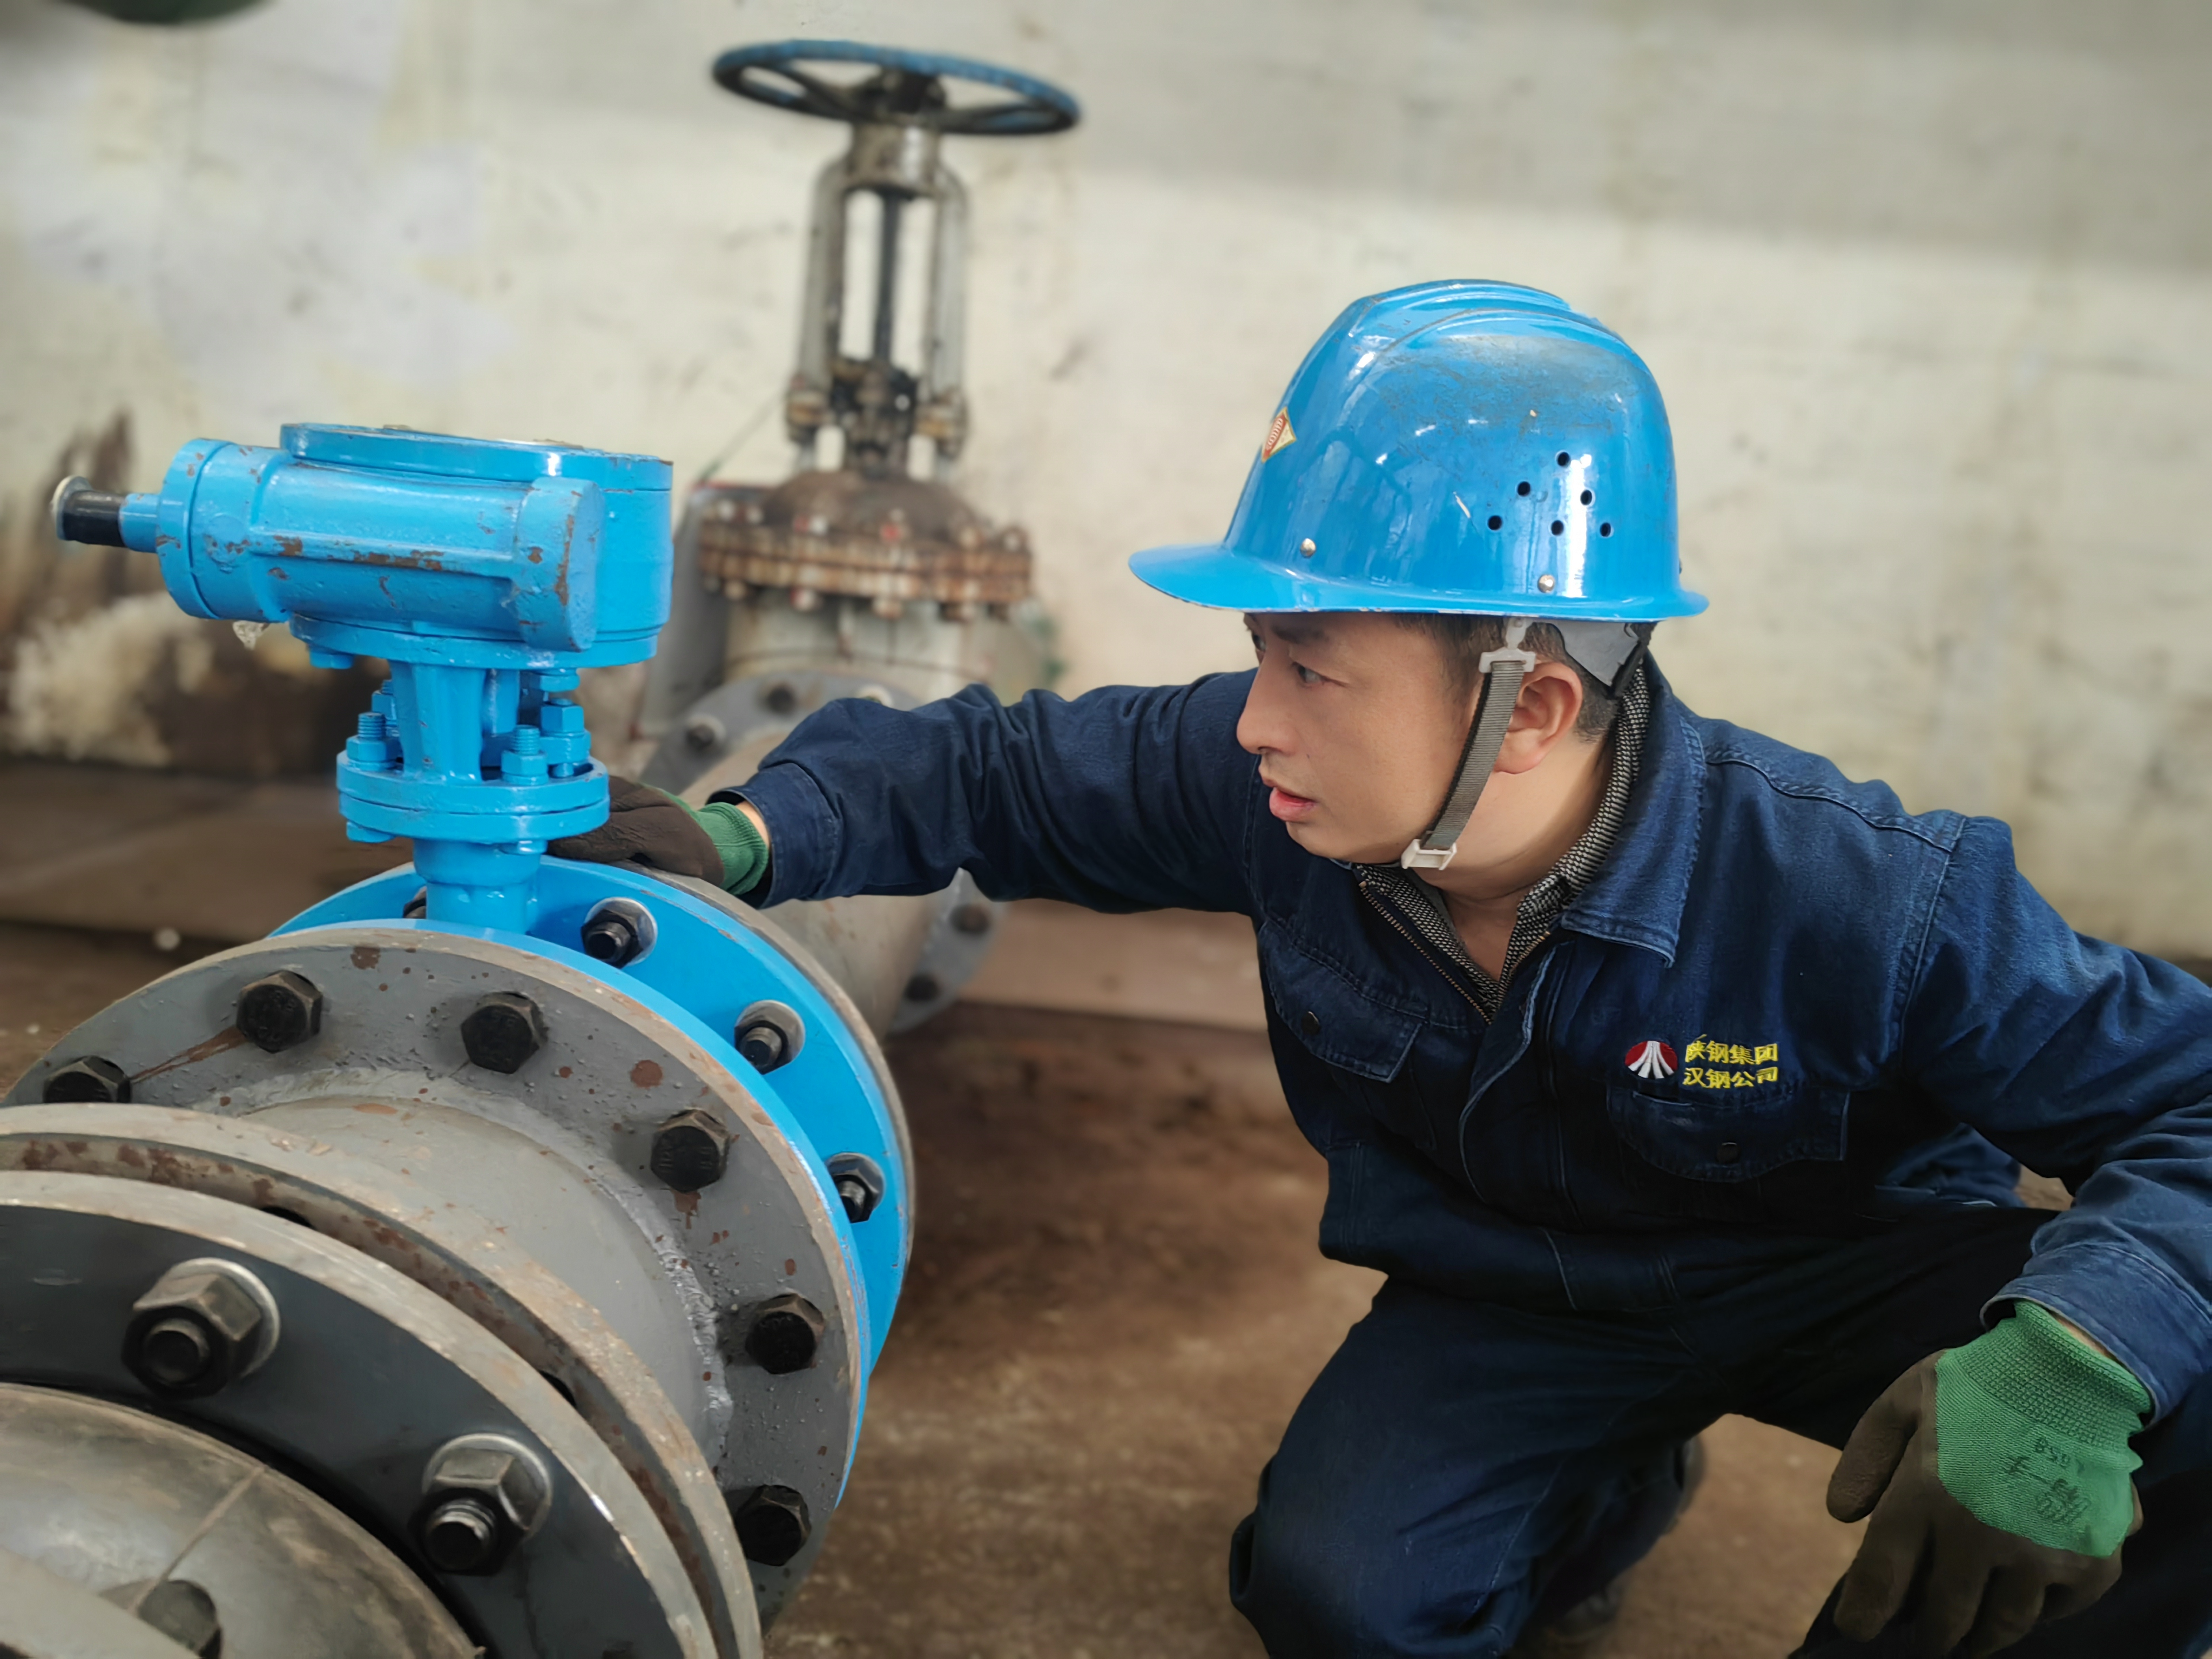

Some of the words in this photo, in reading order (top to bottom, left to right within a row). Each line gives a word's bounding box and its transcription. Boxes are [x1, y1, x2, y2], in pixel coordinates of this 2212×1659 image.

[1684, 1038, 1778, 1065] 陕钢集团
[1682, 1067, 1778, 1089] 汉钢公司
